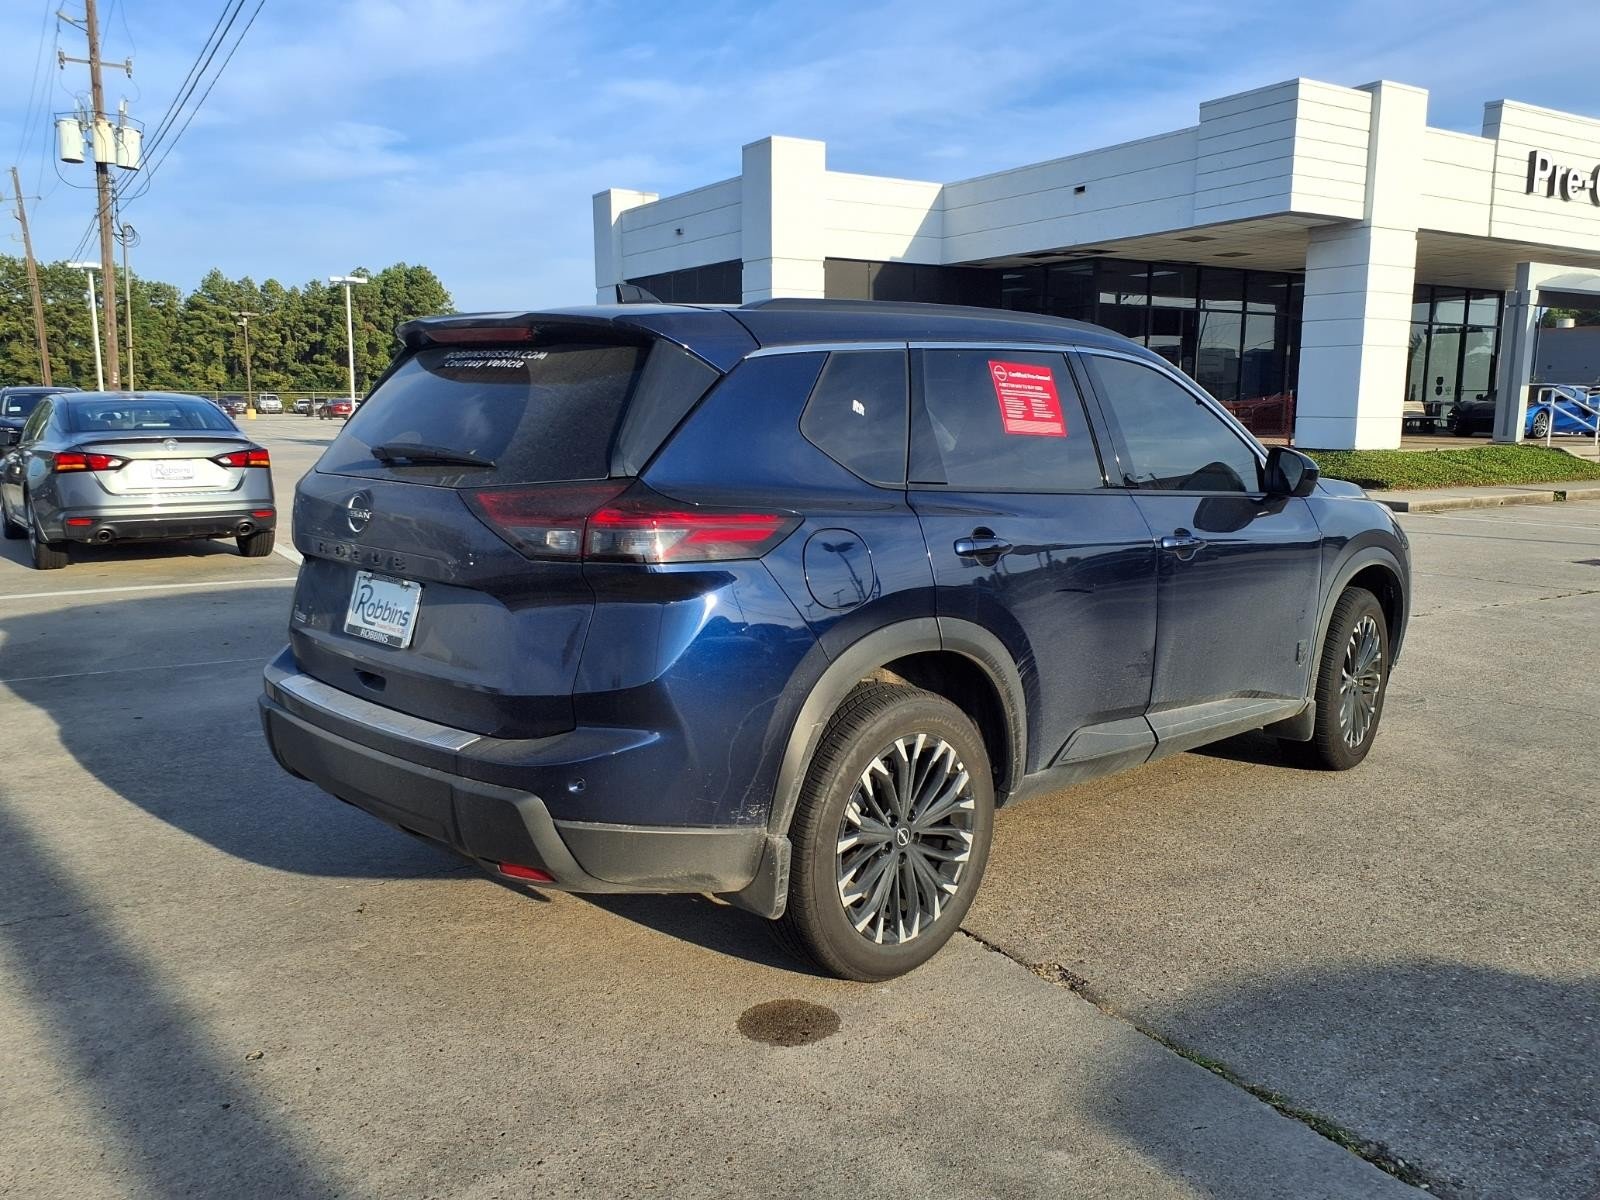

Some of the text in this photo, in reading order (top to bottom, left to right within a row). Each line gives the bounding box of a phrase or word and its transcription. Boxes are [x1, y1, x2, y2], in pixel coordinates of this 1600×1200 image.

[487, 359, 525, 368] Vehicle
[355, 584, 411, 627] Robbins
[360, 628, 389, 643] ROBBINS
